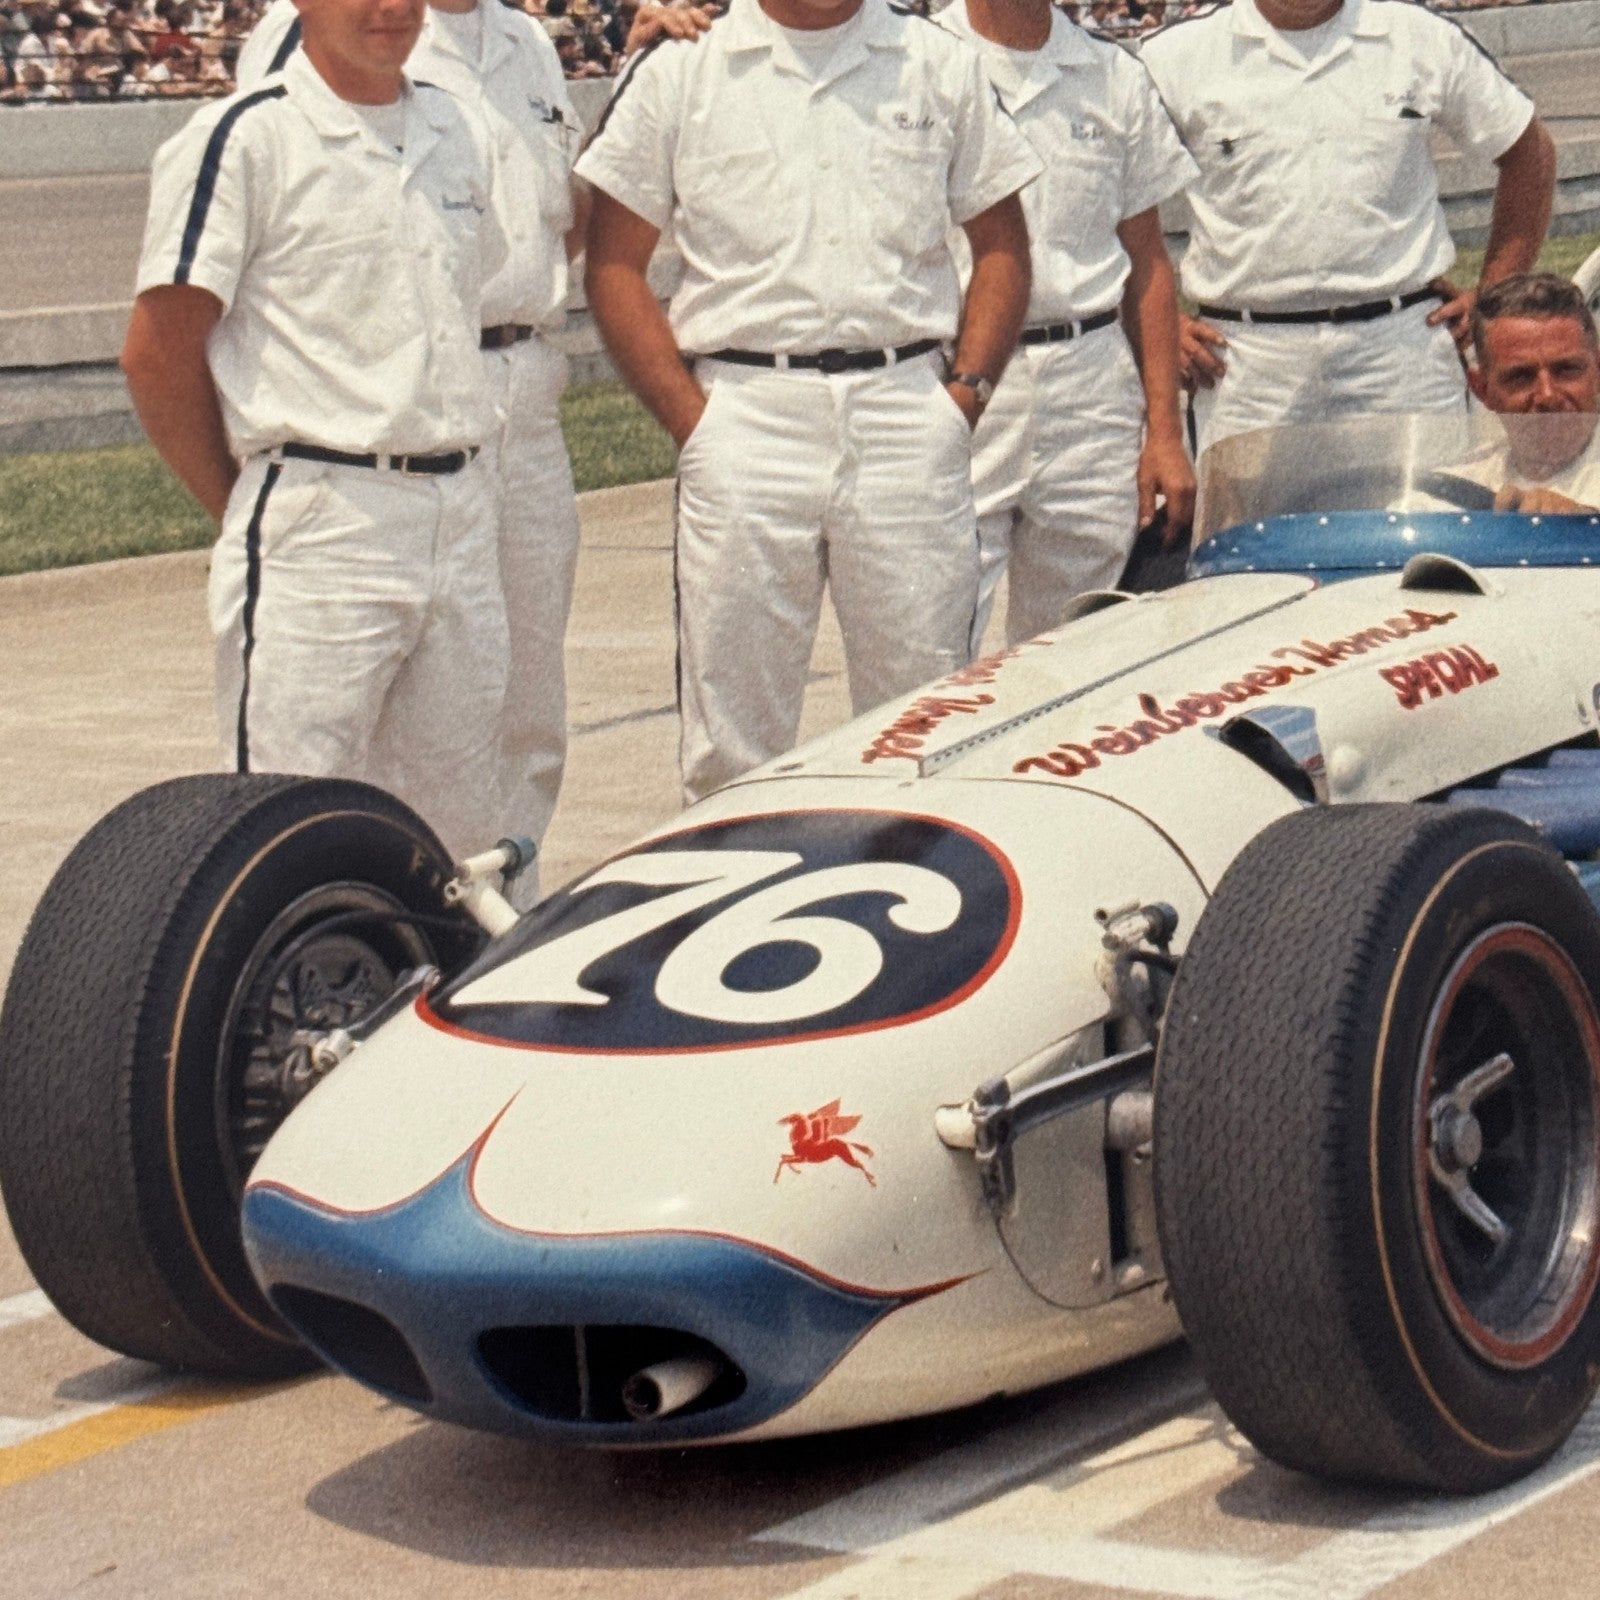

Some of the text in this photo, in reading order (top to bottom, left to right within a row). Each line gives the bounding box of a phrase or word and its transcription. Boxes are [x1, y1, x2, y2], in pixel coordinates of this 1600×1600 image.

[1013, 665, 1316, 778] Weinberger
[1271, 609, 1458, 667] Homes
[449, 850, 963, 1024] 76
